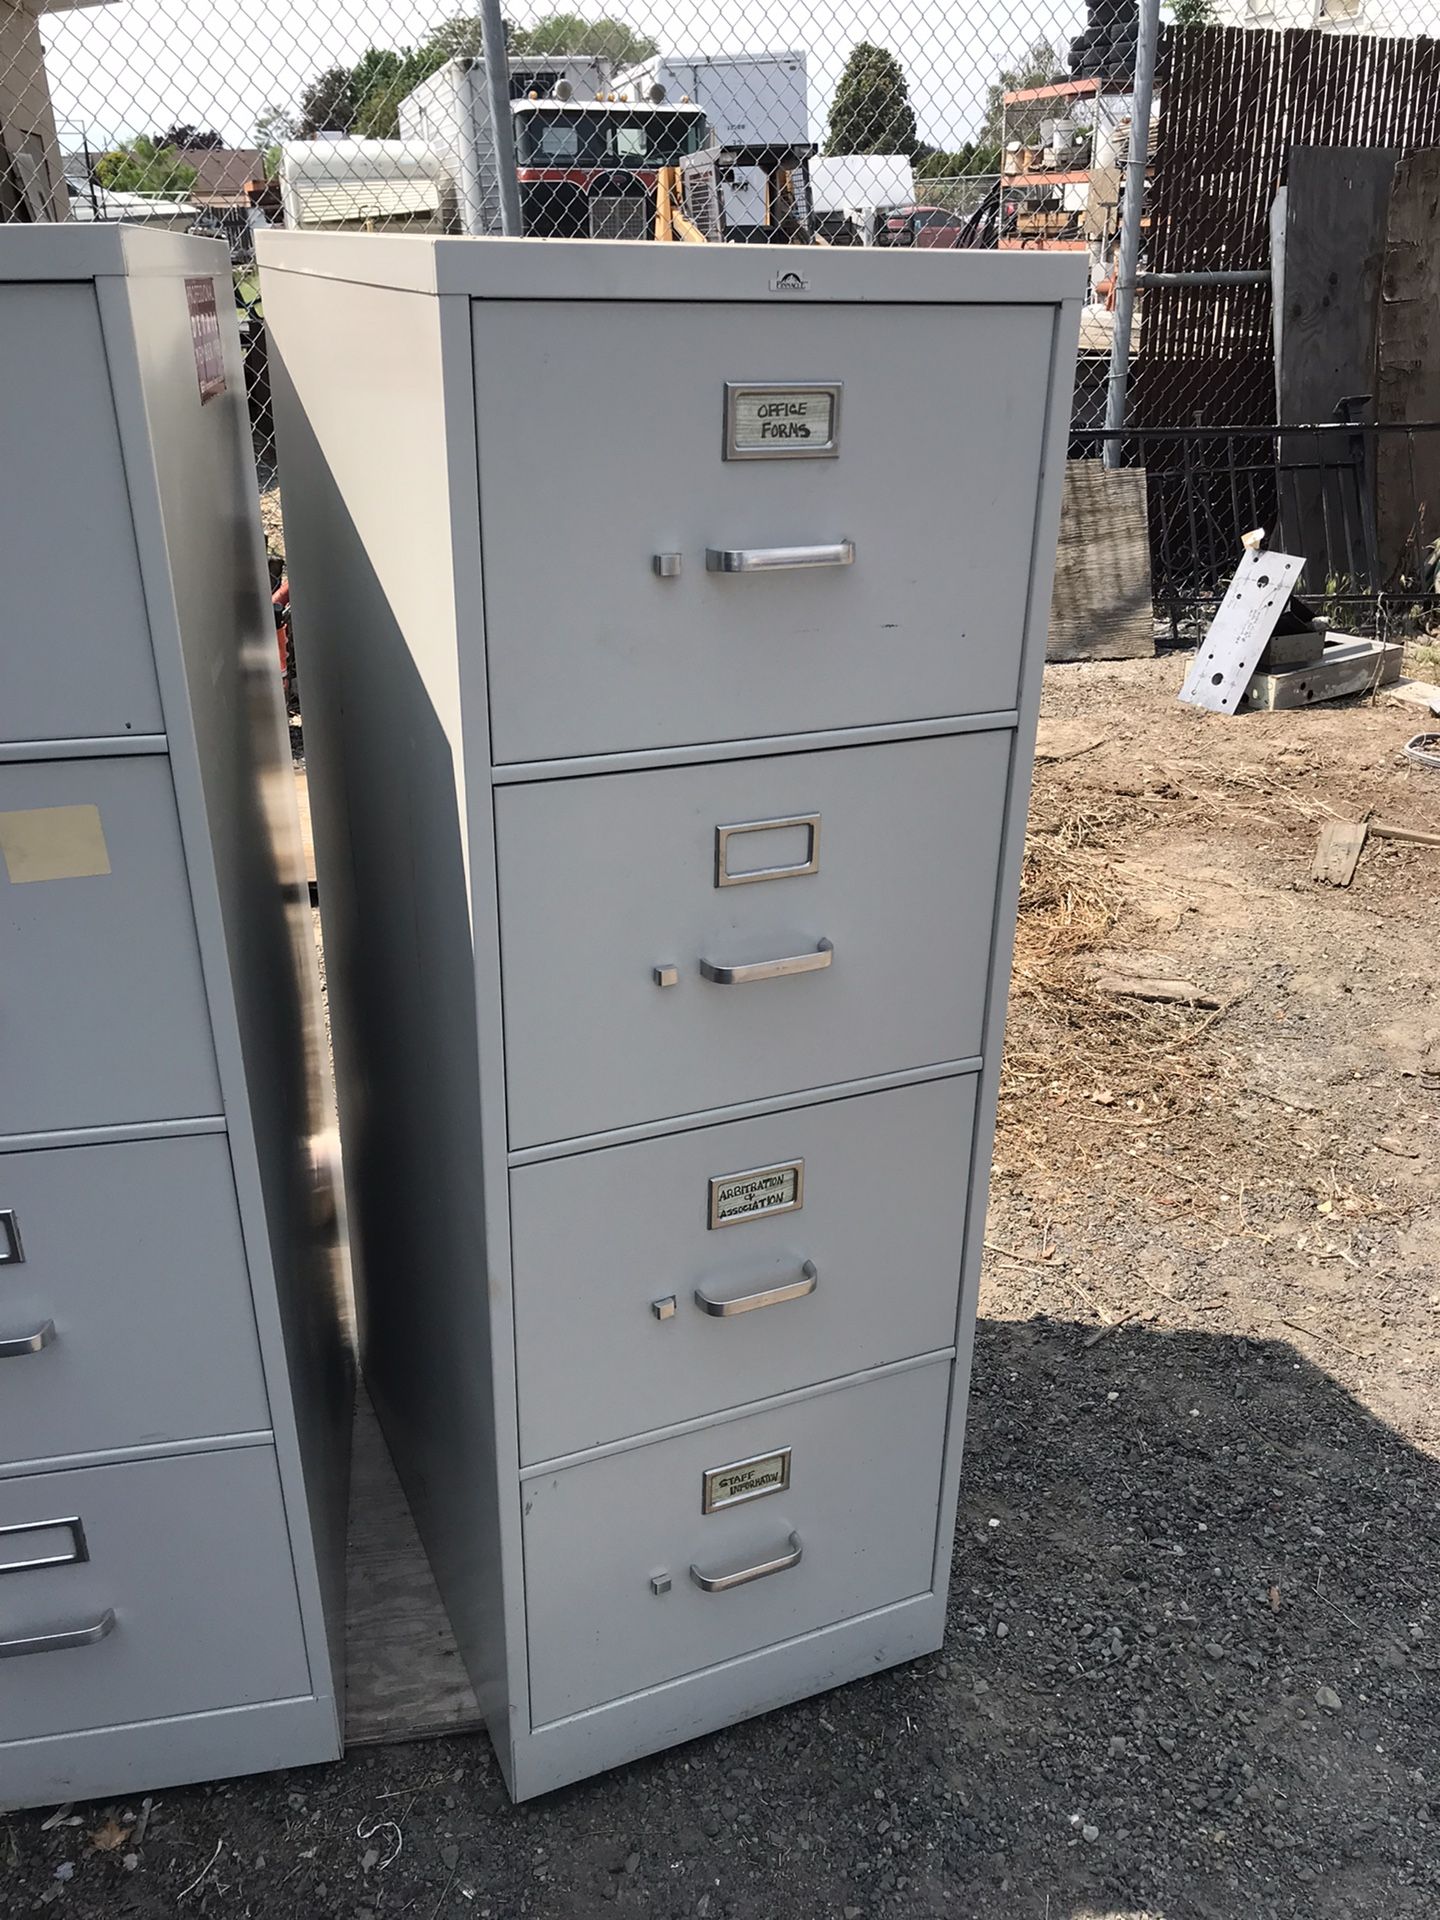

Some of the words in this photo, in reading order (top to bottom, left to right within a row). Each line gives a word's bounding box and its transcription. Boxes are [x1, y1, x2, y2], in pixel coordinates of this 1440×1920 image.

[757, 402, 808, 418] OFFICE
[718, 1174, 784, 1202] ARBITRATION
[719, 1192, 784, 1218] ASSOCIATION
[718, 1470, 755, 1488] STAFF
